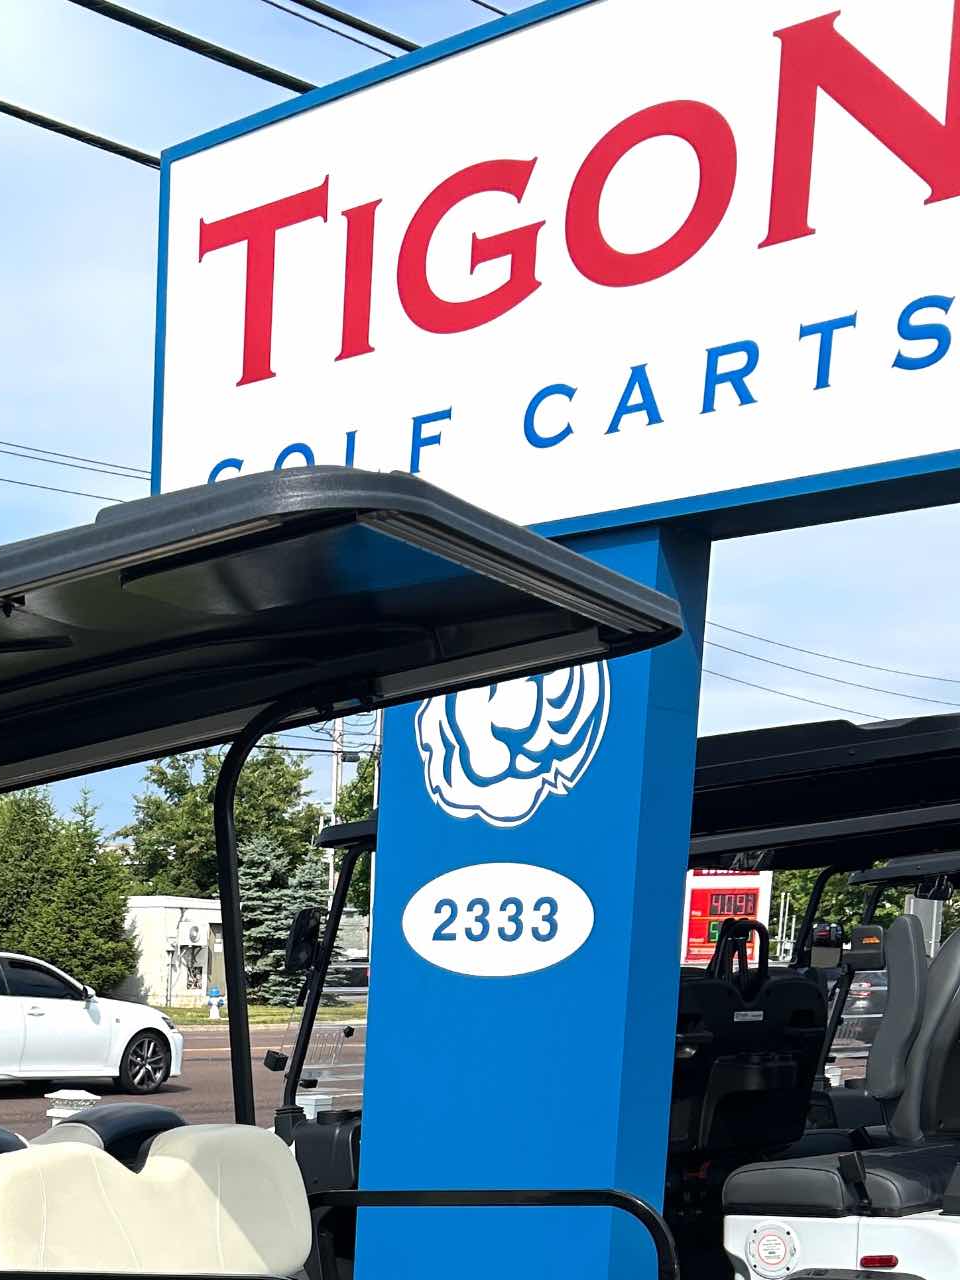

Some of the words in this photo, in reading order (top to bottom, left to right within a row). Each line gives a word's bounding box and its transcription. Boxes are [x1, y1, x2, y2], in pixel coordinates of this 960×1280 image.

[199, 0, 960, 387] TIGON
[523, 295, 955, 448] CARTS
[432, 896, 558, 942] 2333
